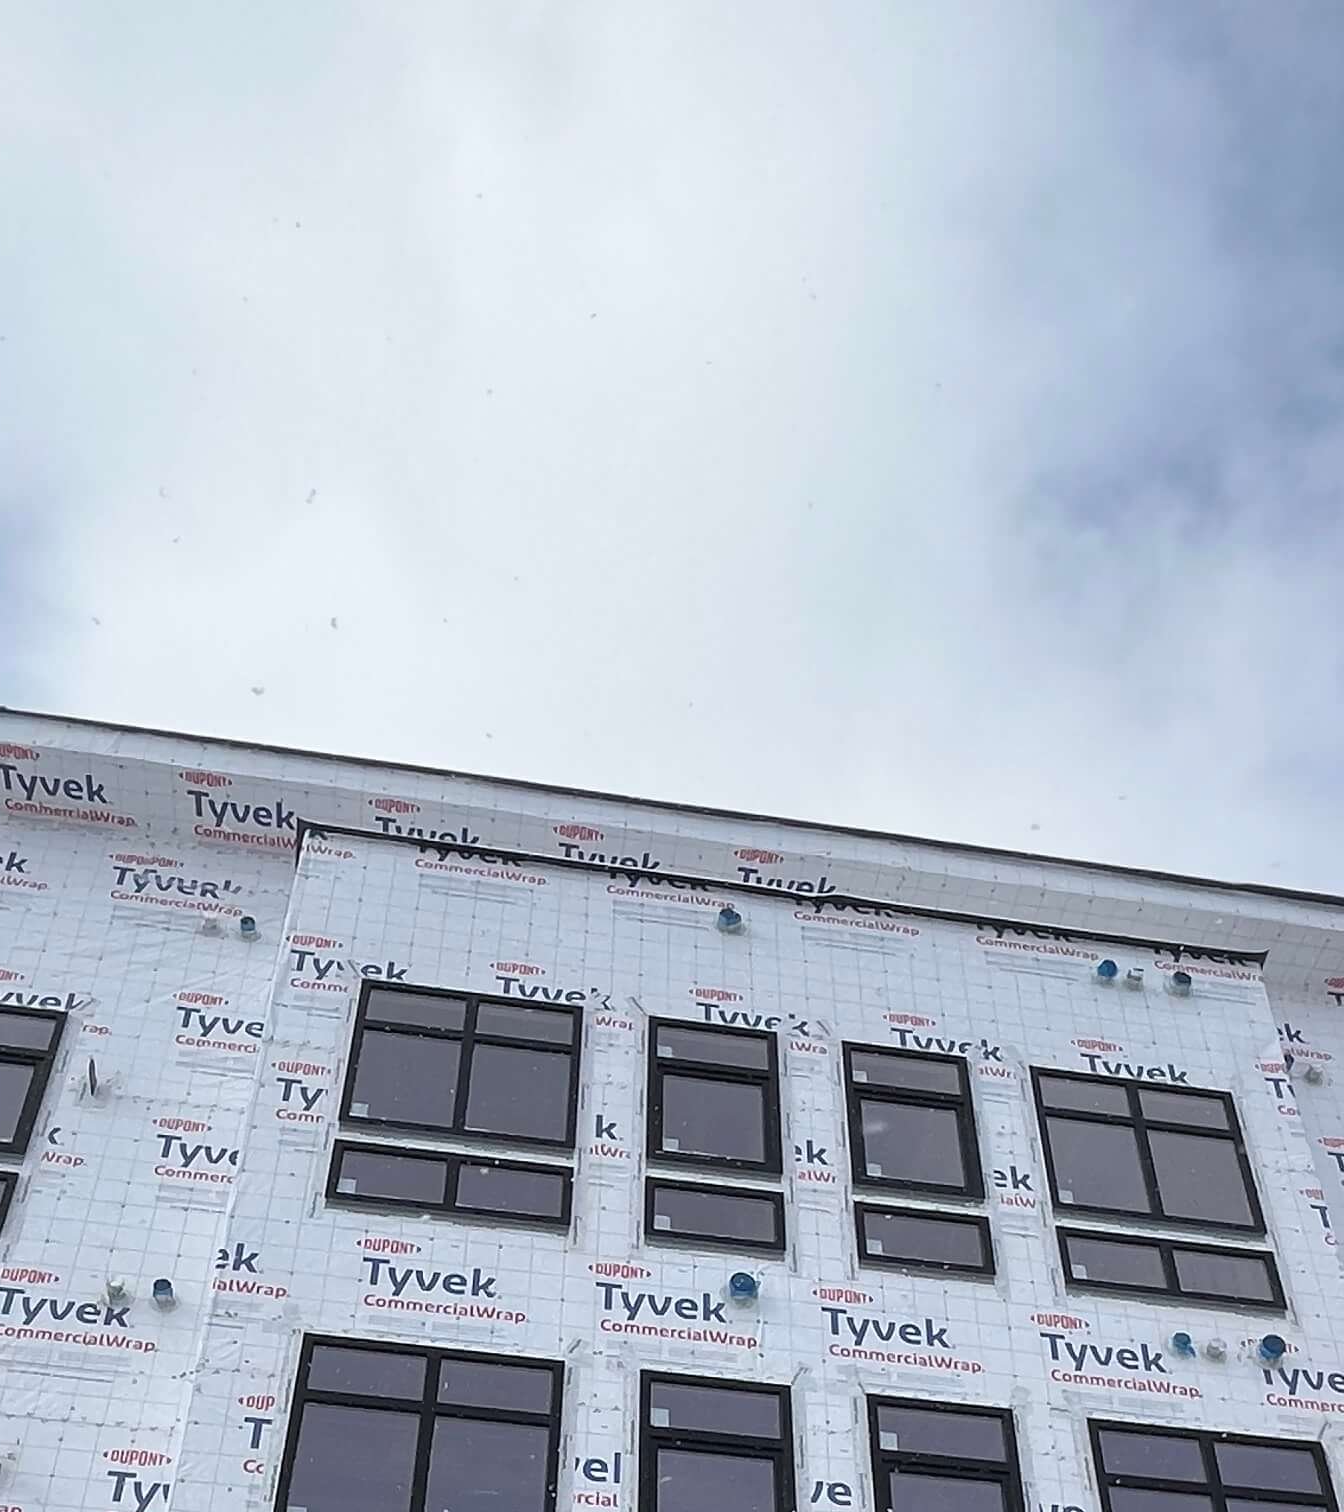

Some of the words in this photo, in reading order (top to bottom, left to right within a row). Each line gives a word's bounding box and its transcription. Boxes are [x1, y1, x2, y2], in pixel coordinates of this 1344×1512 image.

[5, 799, 135, 826] CommercialWrap
[186, 789, 299, 829] Tyvek
[414, 859, 547, 885] CommercialWrap
[606, 885, 735, 911] CommercialWrap
[794, 911, 919, 936] CommercialWrap
[976, 936, 1099, 961] CommercialWrap
[176, 1007, 264, 1038] Tyve
[362, 1257, 496, 1298] Tyvek
[363, 1294, 526, 1323] CommercialWrap
[595, 1282, 726, 1322] Tyvek
[600, 1318, 757, 1348] CommercialWrap
[821, 1308, 949, 1347] Tyvek
[829, 1344, 982, 1373] CommercialWrap
[1040, 1332, 1167, 1374] Tyvek
[1051, 1369, 1201, 1398] CommercialWrap
[108, 1450, 169, 1466] DUPONT
